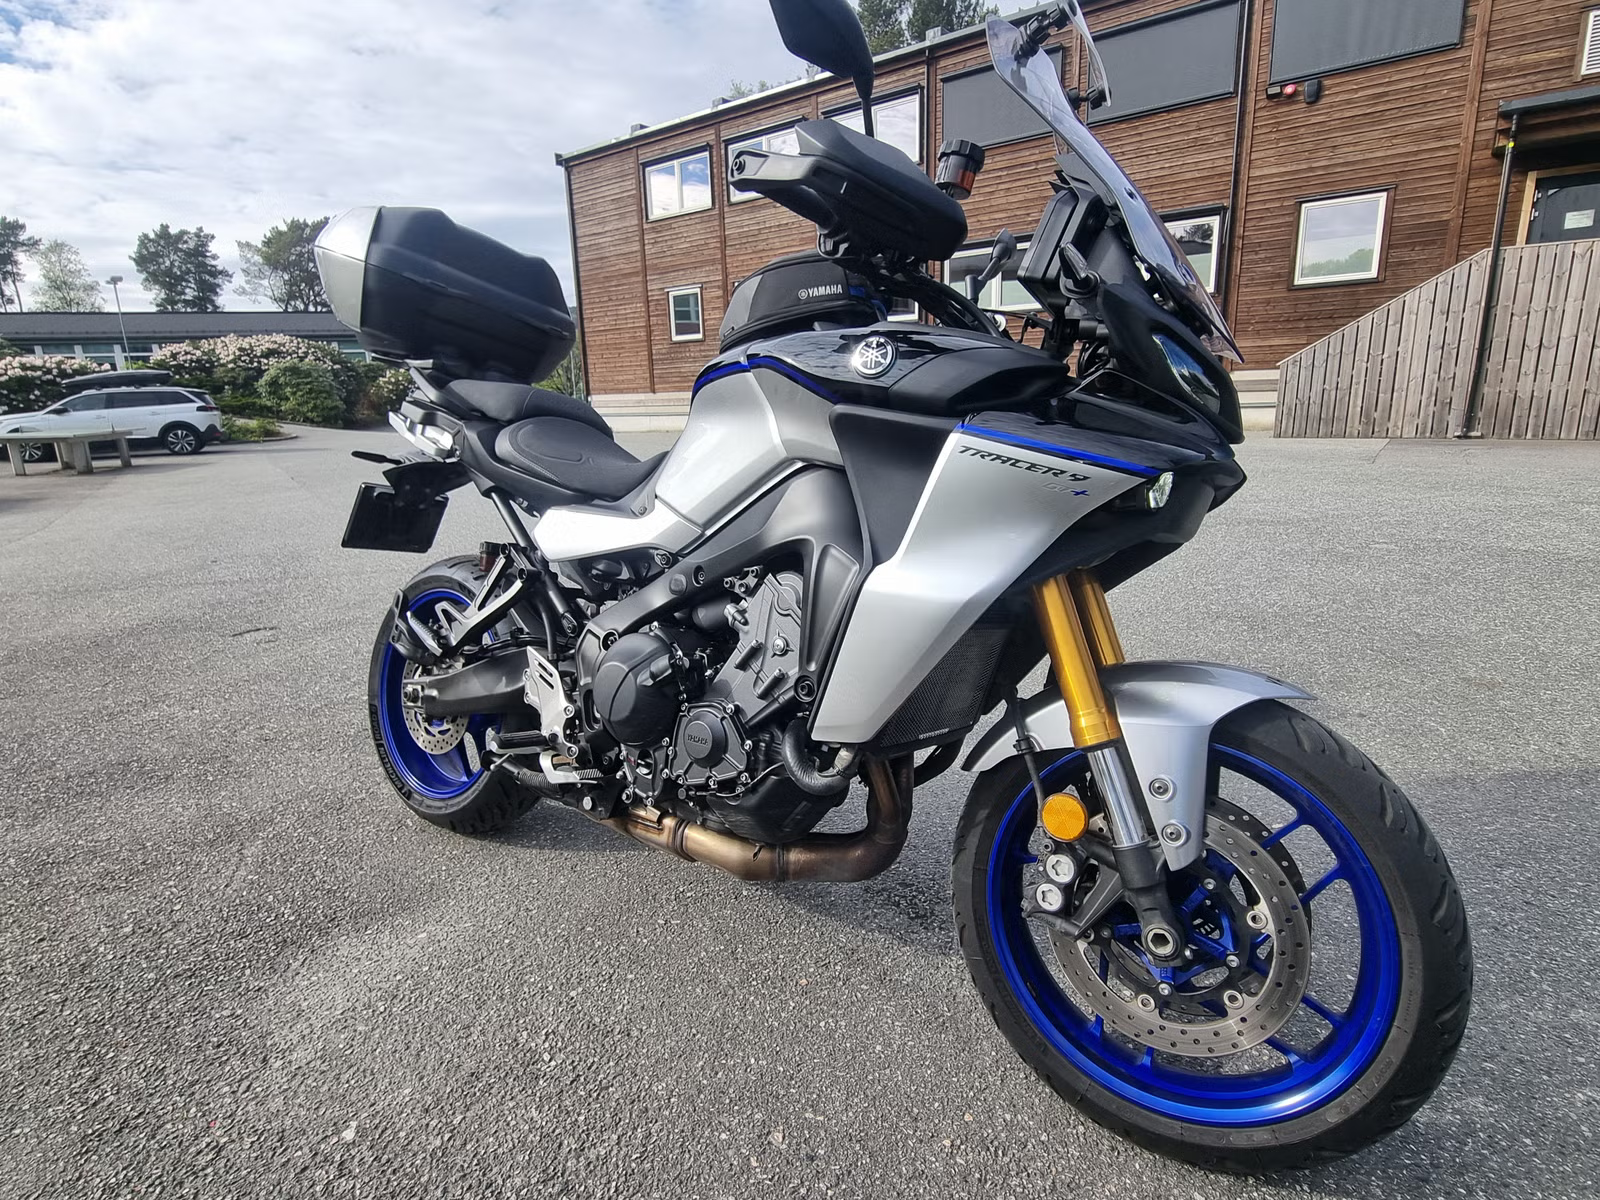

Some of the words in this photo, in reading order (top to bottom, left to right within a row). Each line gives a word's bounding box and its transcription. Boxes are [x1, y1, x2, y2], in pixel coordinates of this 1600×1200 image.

[808, 284, 843, 298] YAMAHA
[958, 445, 1069, 478] TRACER
[1067, 473, 1092, 482] 9
[371, 713, 382, 740] ROAD
[378, 746, 404, 790] MICHELIN
